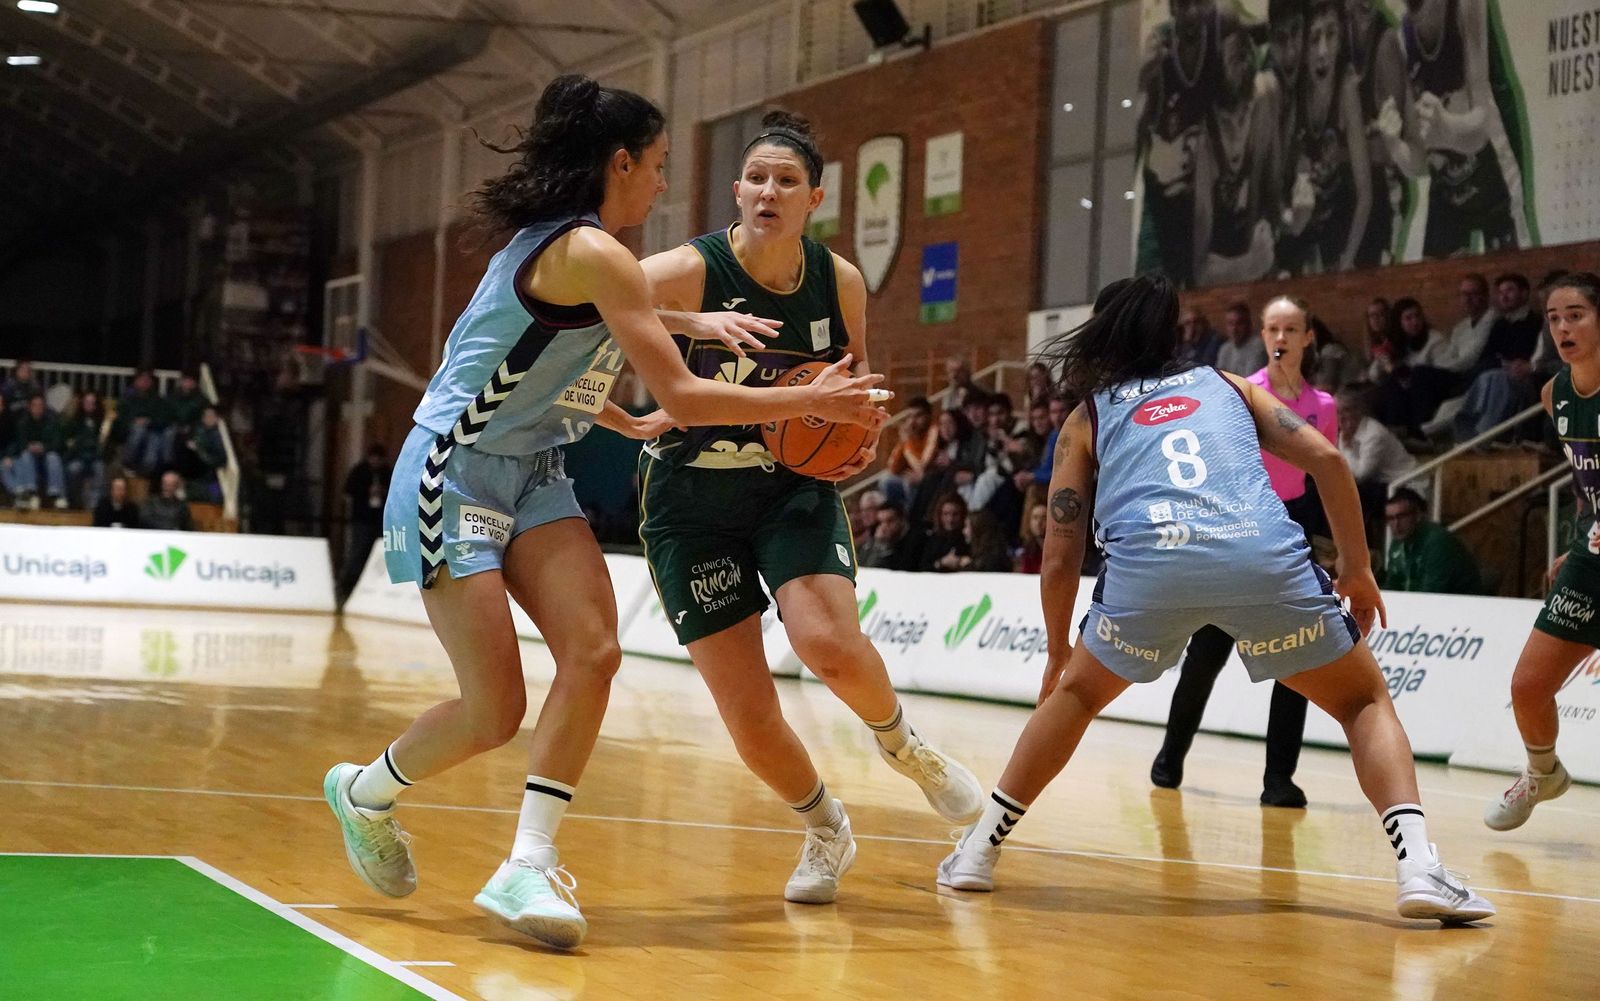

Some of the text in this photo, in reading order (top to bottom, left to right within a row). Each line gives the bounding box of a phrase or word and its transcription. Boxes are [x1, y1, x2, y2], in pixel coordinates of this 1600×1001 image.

[1548, 51, 1600, 97] NUES
[565, 390, 596, 406] DE VIGO
[1144, 403, 1188, 421] Zorka
[1161, 429, 1208, 488] 8
[1175, 495, 1221, 511] XUNTA
[1177, 502, 1254, 521] DE GALICIA
[464, 513, 511, 532] CONCELLO
[472, 525, 505, 542] DE VIGO
[4, 554, 107, 582] Unicaja
[196, 560, 296, 588] Unicaja
[691, 556, 733, 574] CLINICAS
[703, 592, 740, 613] DENTAL
[1547, 612, 1578, 630] DENTAL
[1237, 615, 1325, 657] Recalvi
[1365, 624, 1484, 661] undación
[1114, 637, 1160, 662] travel
